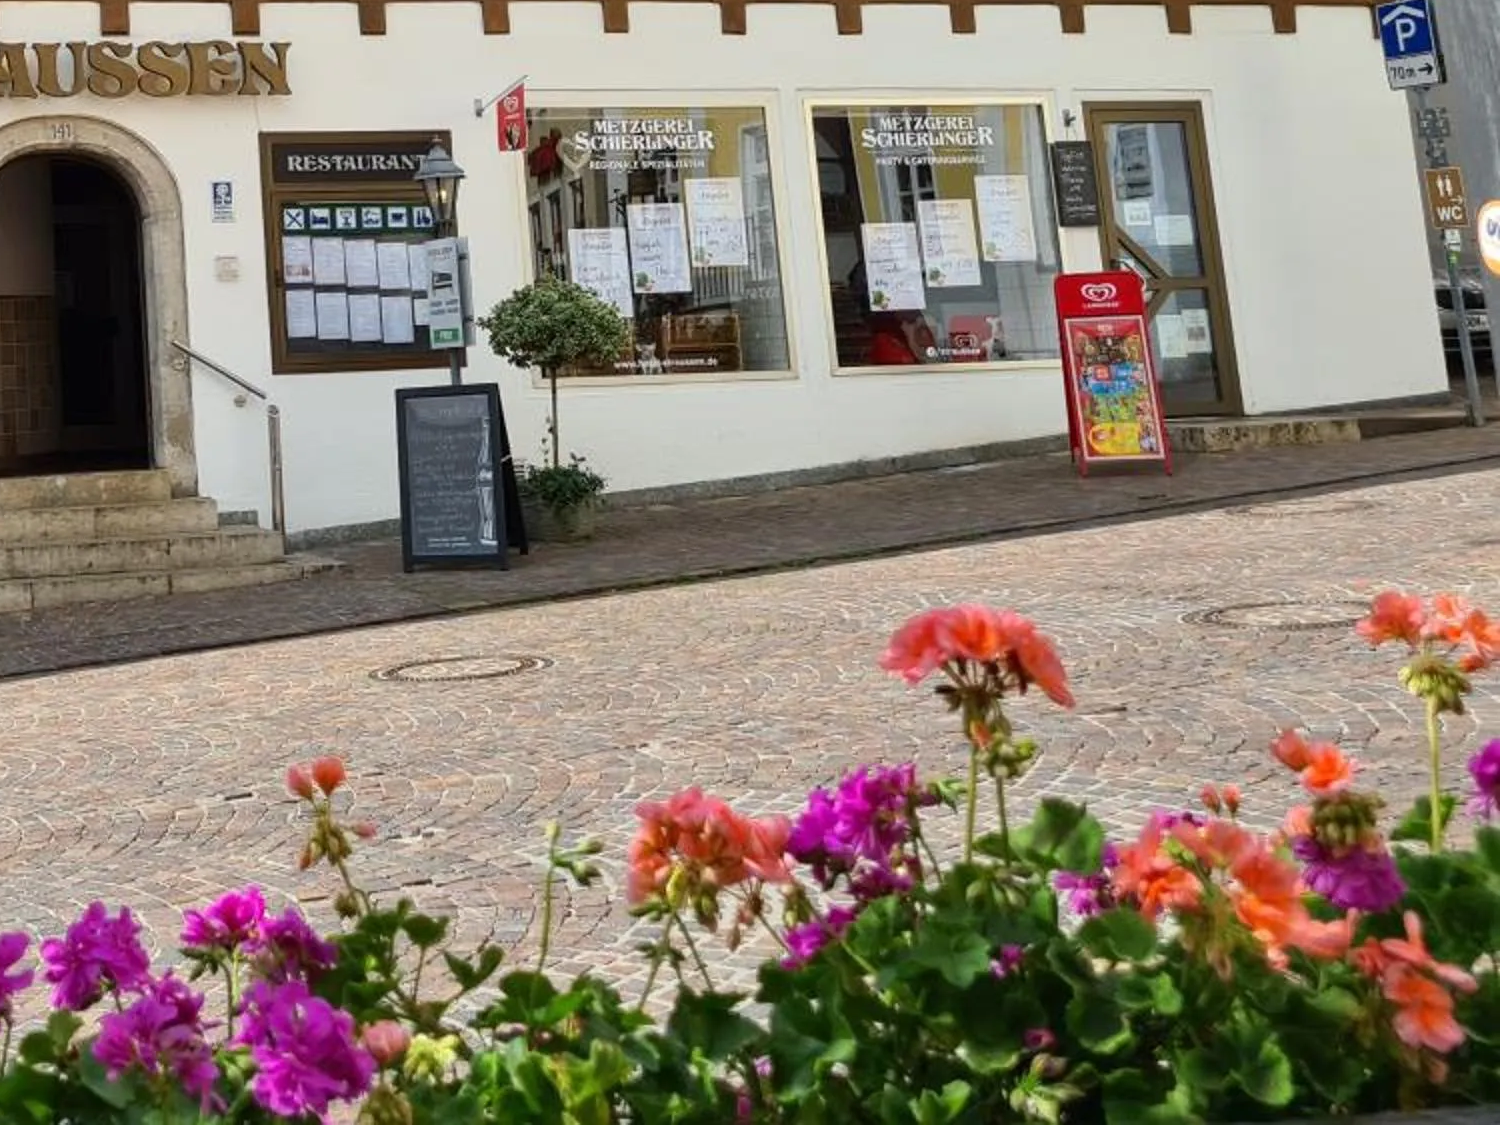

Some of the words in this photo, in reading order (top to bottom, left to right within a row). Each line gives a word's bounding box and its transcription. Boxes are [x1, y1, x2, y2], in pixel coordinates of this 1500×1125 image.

[1395, 18, 1416, 52] P
[593, 118, 694, 134] METZGEREI
[879, 115, 975, 132] METZGEREI
[861, 126, 994, 148] SCHIERLINGER
[1436, 206, 1463, 221] WC
